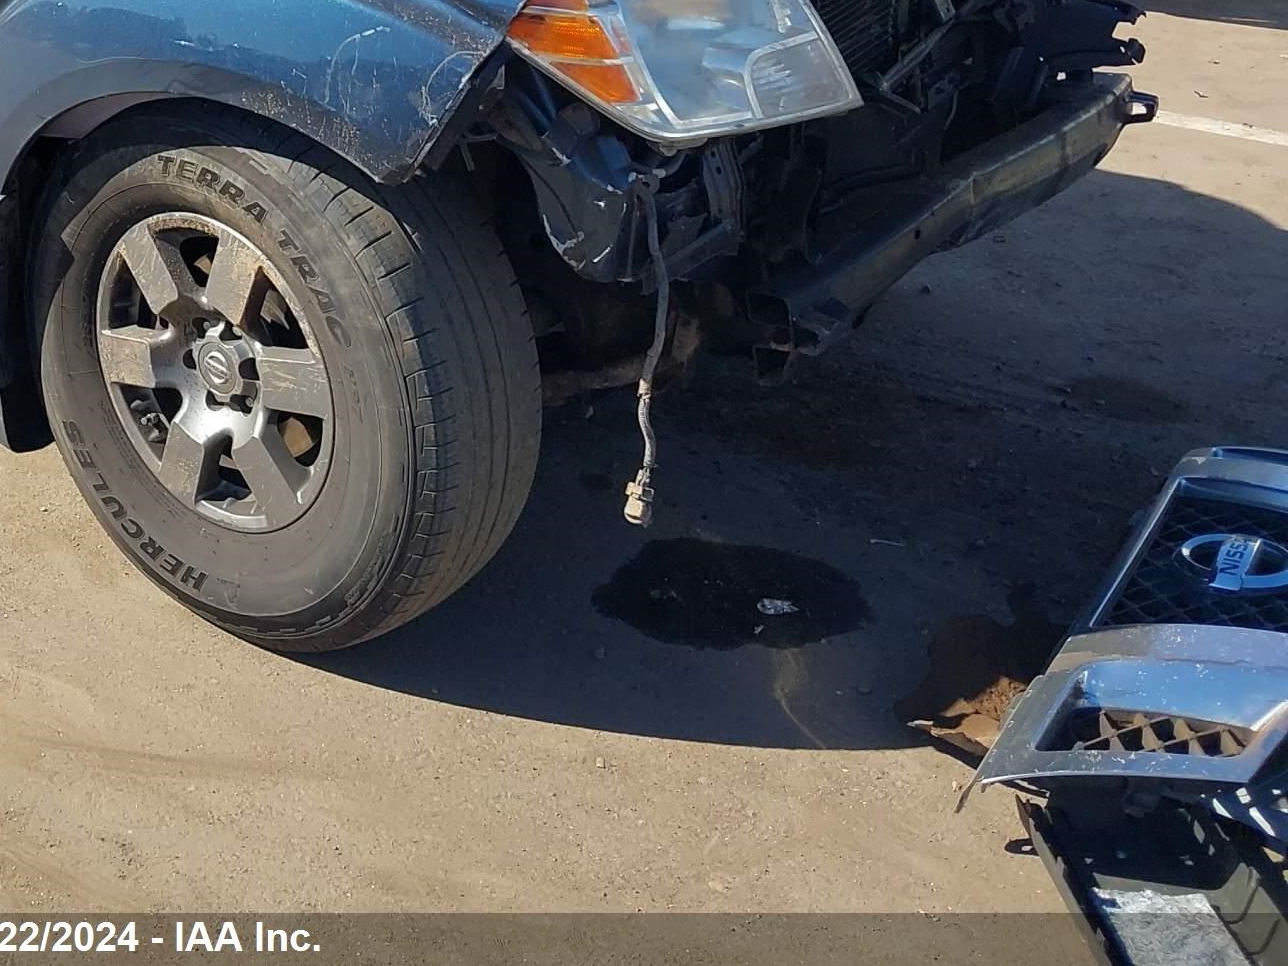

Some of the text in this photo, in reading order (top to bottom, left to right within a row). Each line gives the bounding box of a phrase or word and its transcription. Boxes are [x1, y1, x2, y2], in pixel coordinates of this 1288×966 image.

[156, 154, 352, 349] TERRA TRAC
[62, 418, 209, 593] HERCULES
